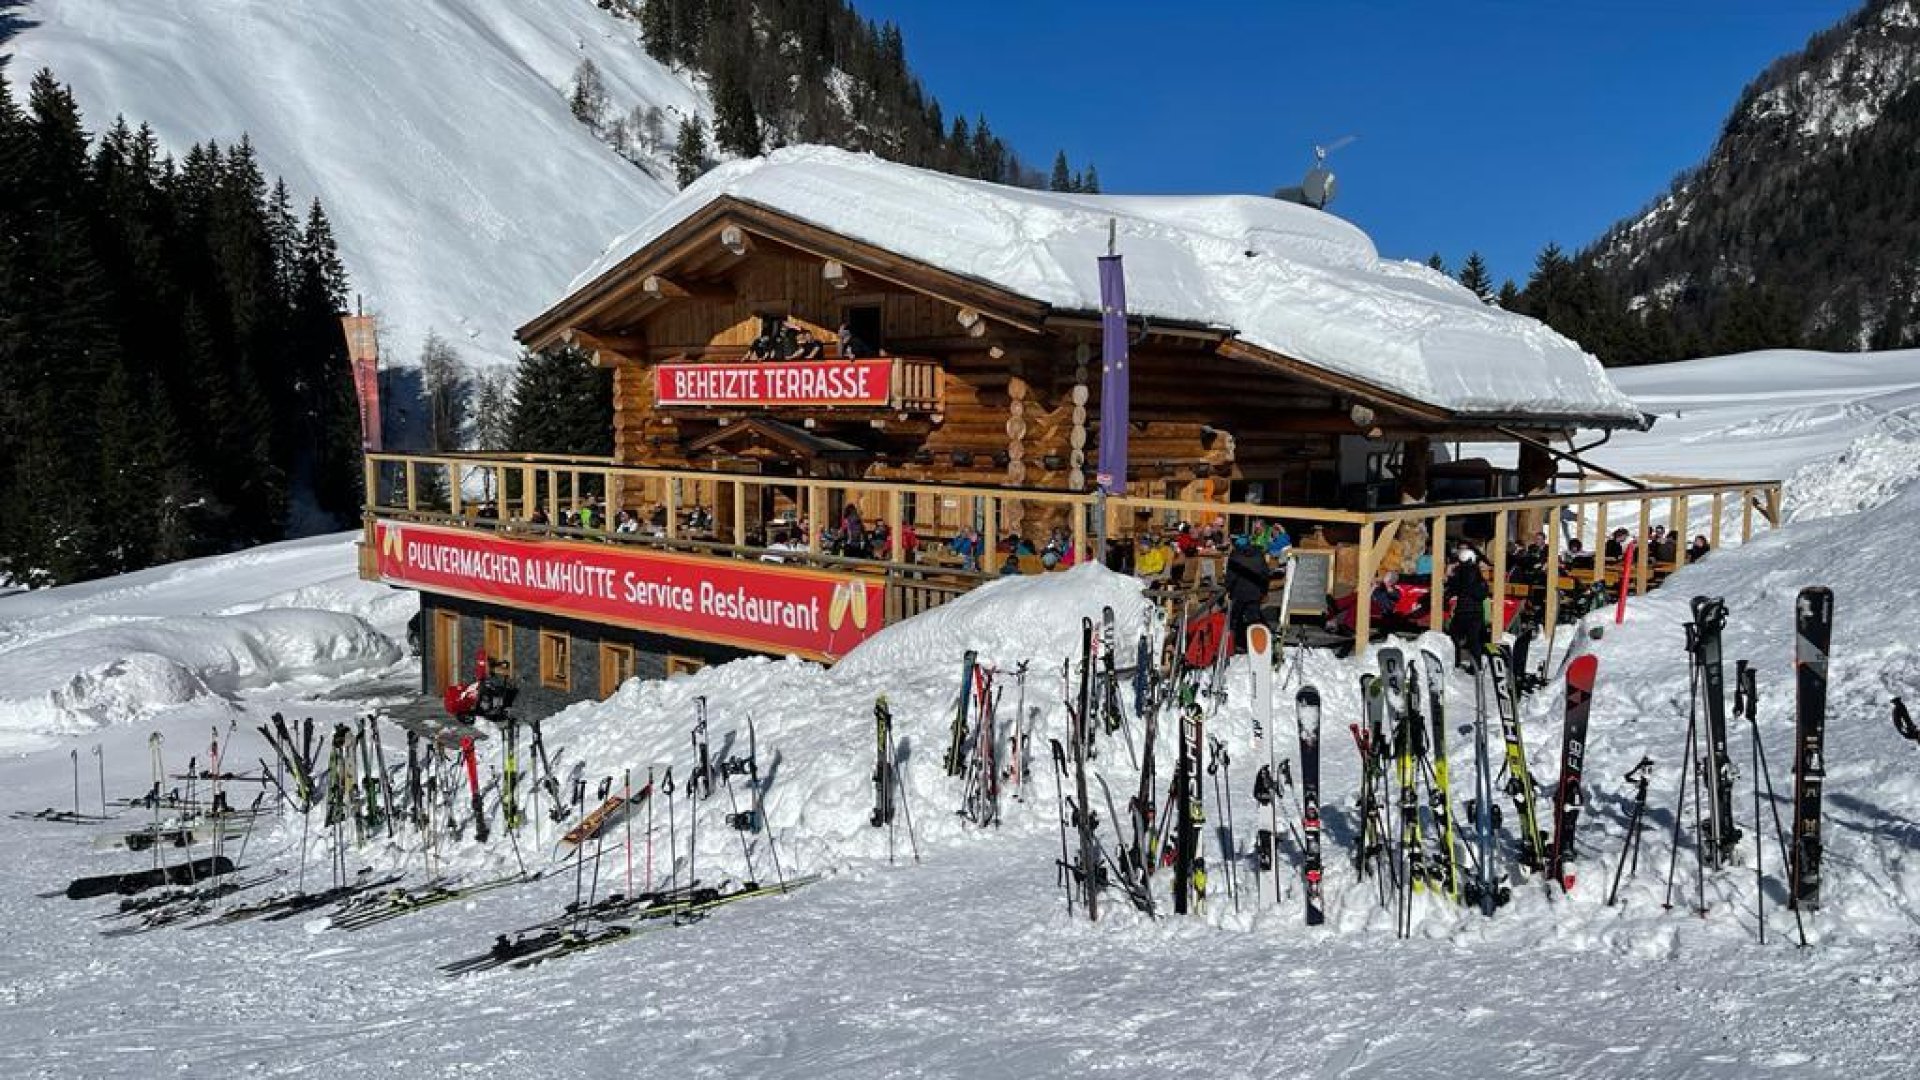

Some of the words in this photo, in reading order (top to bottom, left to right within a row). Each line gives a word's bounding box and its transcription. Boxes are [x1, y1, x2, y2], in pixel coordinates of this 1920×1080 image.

[675, 370, 760, 399] BEHEIZTE
[763, 367, 871, 398] TERRASSE
[407, 541, 522, 586] PULVERMACHER
[526, 560, 617, 599] ALMHÜTTE
[623, 571, 694, 612] Service
[700, 581, 820, 632] Restaurant
[1493, 656, 1518, 741] HEAD
